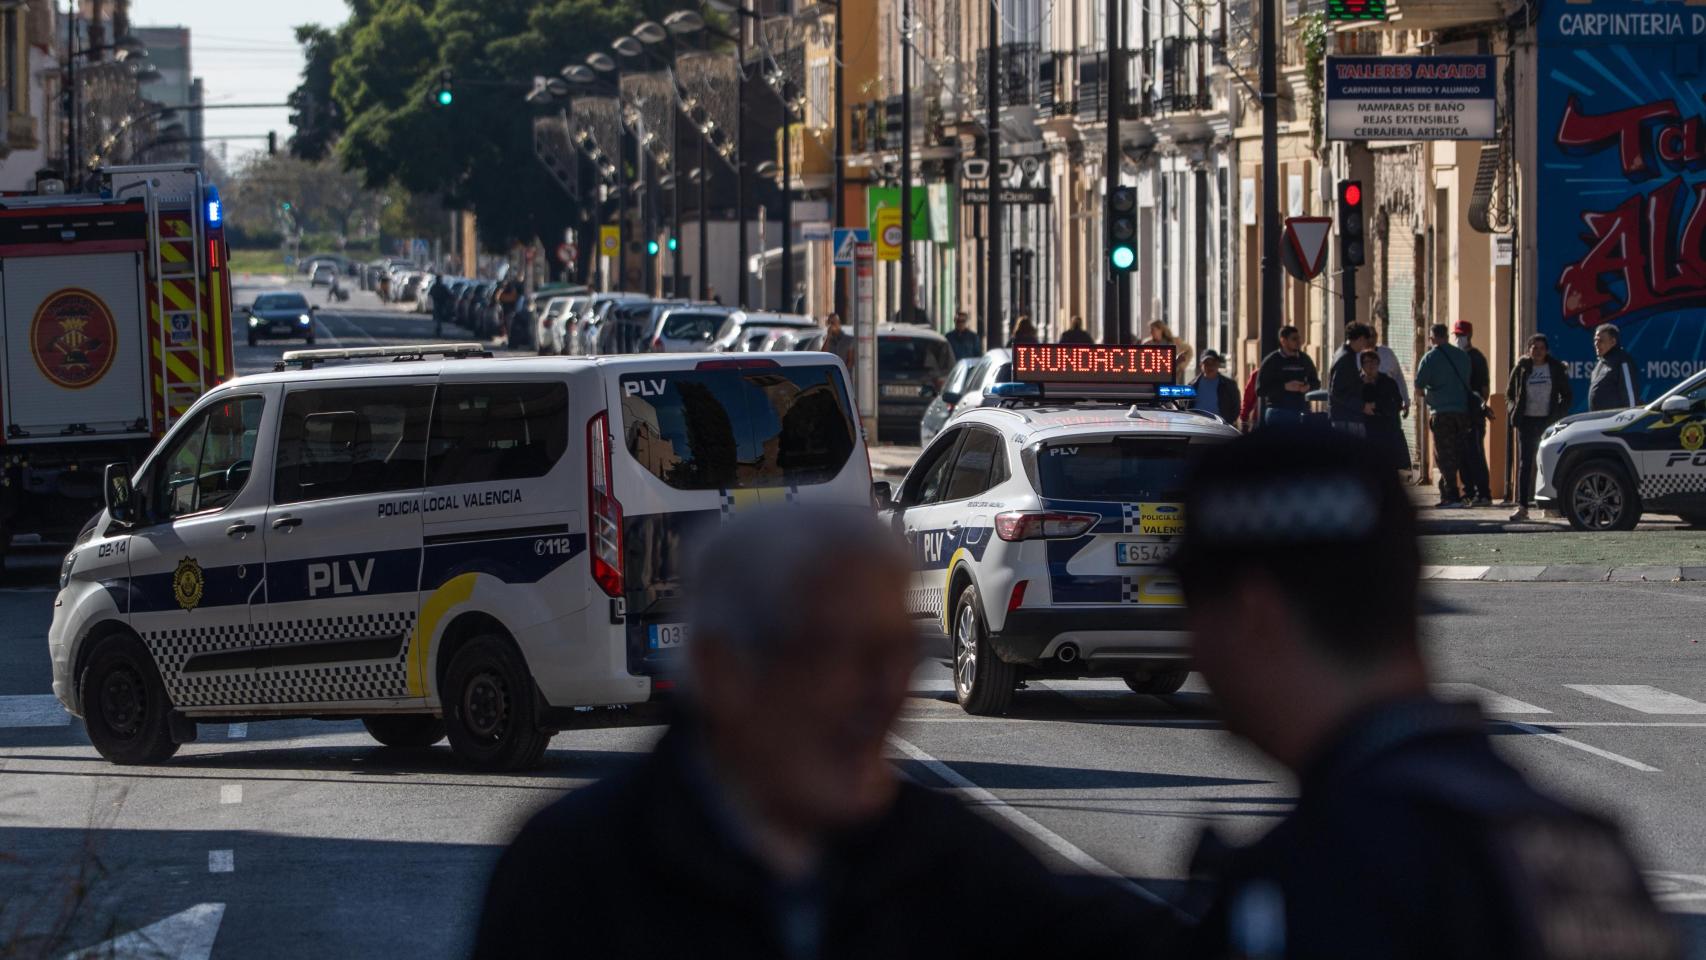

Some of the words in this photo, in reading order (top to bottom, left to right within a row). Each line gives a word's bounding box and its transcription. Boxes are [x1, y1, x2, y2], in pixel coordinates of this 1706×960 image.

[1559, 13, 1684, 35] CARPINTERIA
[1336, 63, 1412, 80] TALLERES
[1415, 63, 1487, 80] ALCAIDE
[1342, 86, 1391, 94] CARPINTERIA
[1392, 86, 1402, 94] DE
[1404, 86, 1433, 94] HIERRO
[1434, 86, 1440, 94] Y
[1441, 86, 1481, 94] ALUMINIO
[1357, 103, 1415, 112] MAMPARAS
[1417, 103, 1432, 112] DE
[1435, 101, 1465, 112] BAÑO
[1363, 115, 1393, 125] REJAS
[1396, 115, 1460, 125] EXTENSIBLES
[1354, 128, 1414, 137] CERRAJERIA
[1417, 128, 1469, 137] ARTISTICA
[1017, 346, 1172, 373] INUNDACION
[623, 378, 667, 398] PLV
[1050, 446, 1079, 457] PLV
[378, 500, 420, 517] POLICIA
[423, 495, 459, 512] LOCAL
[463, 488, 522, 508] VALENCIA
[546, 538, 570, 555] 112
[924, 532, 944, 562] PLV
[308, 558, 375, 597] PLV
